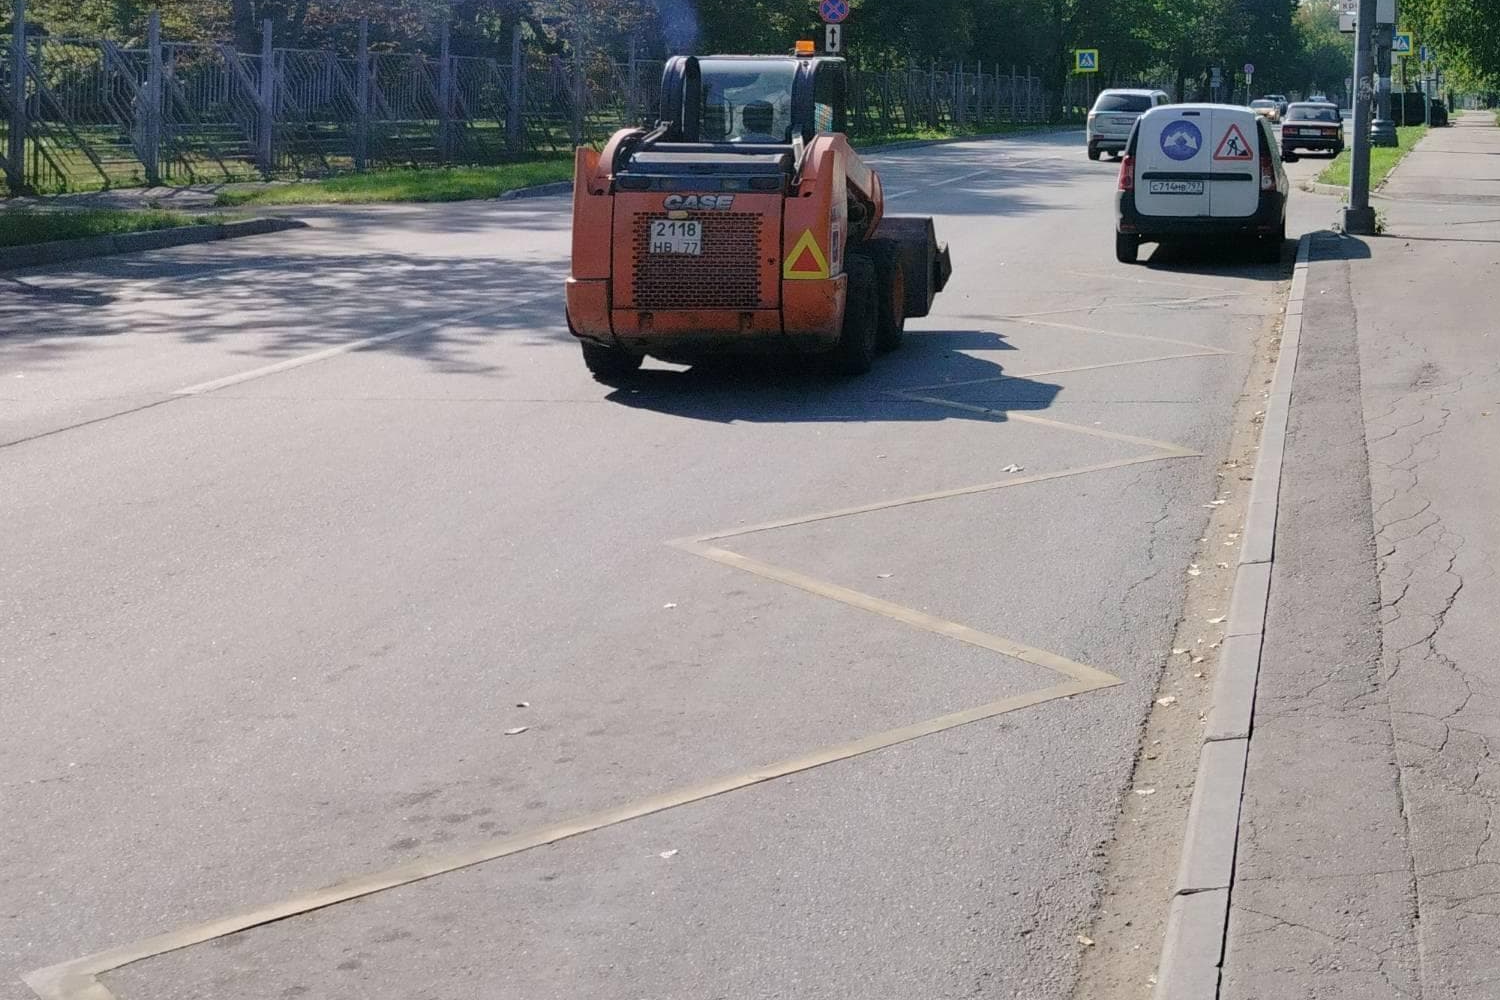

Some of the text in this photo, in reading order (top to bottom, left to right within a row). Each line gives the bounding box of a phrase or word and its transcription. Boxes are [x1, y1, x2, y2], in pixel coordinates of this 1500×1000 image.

[663, 194, 735, 210] CASE
[656, 222, 696, 237] 2118
[683, 242, 698, 254] 77
